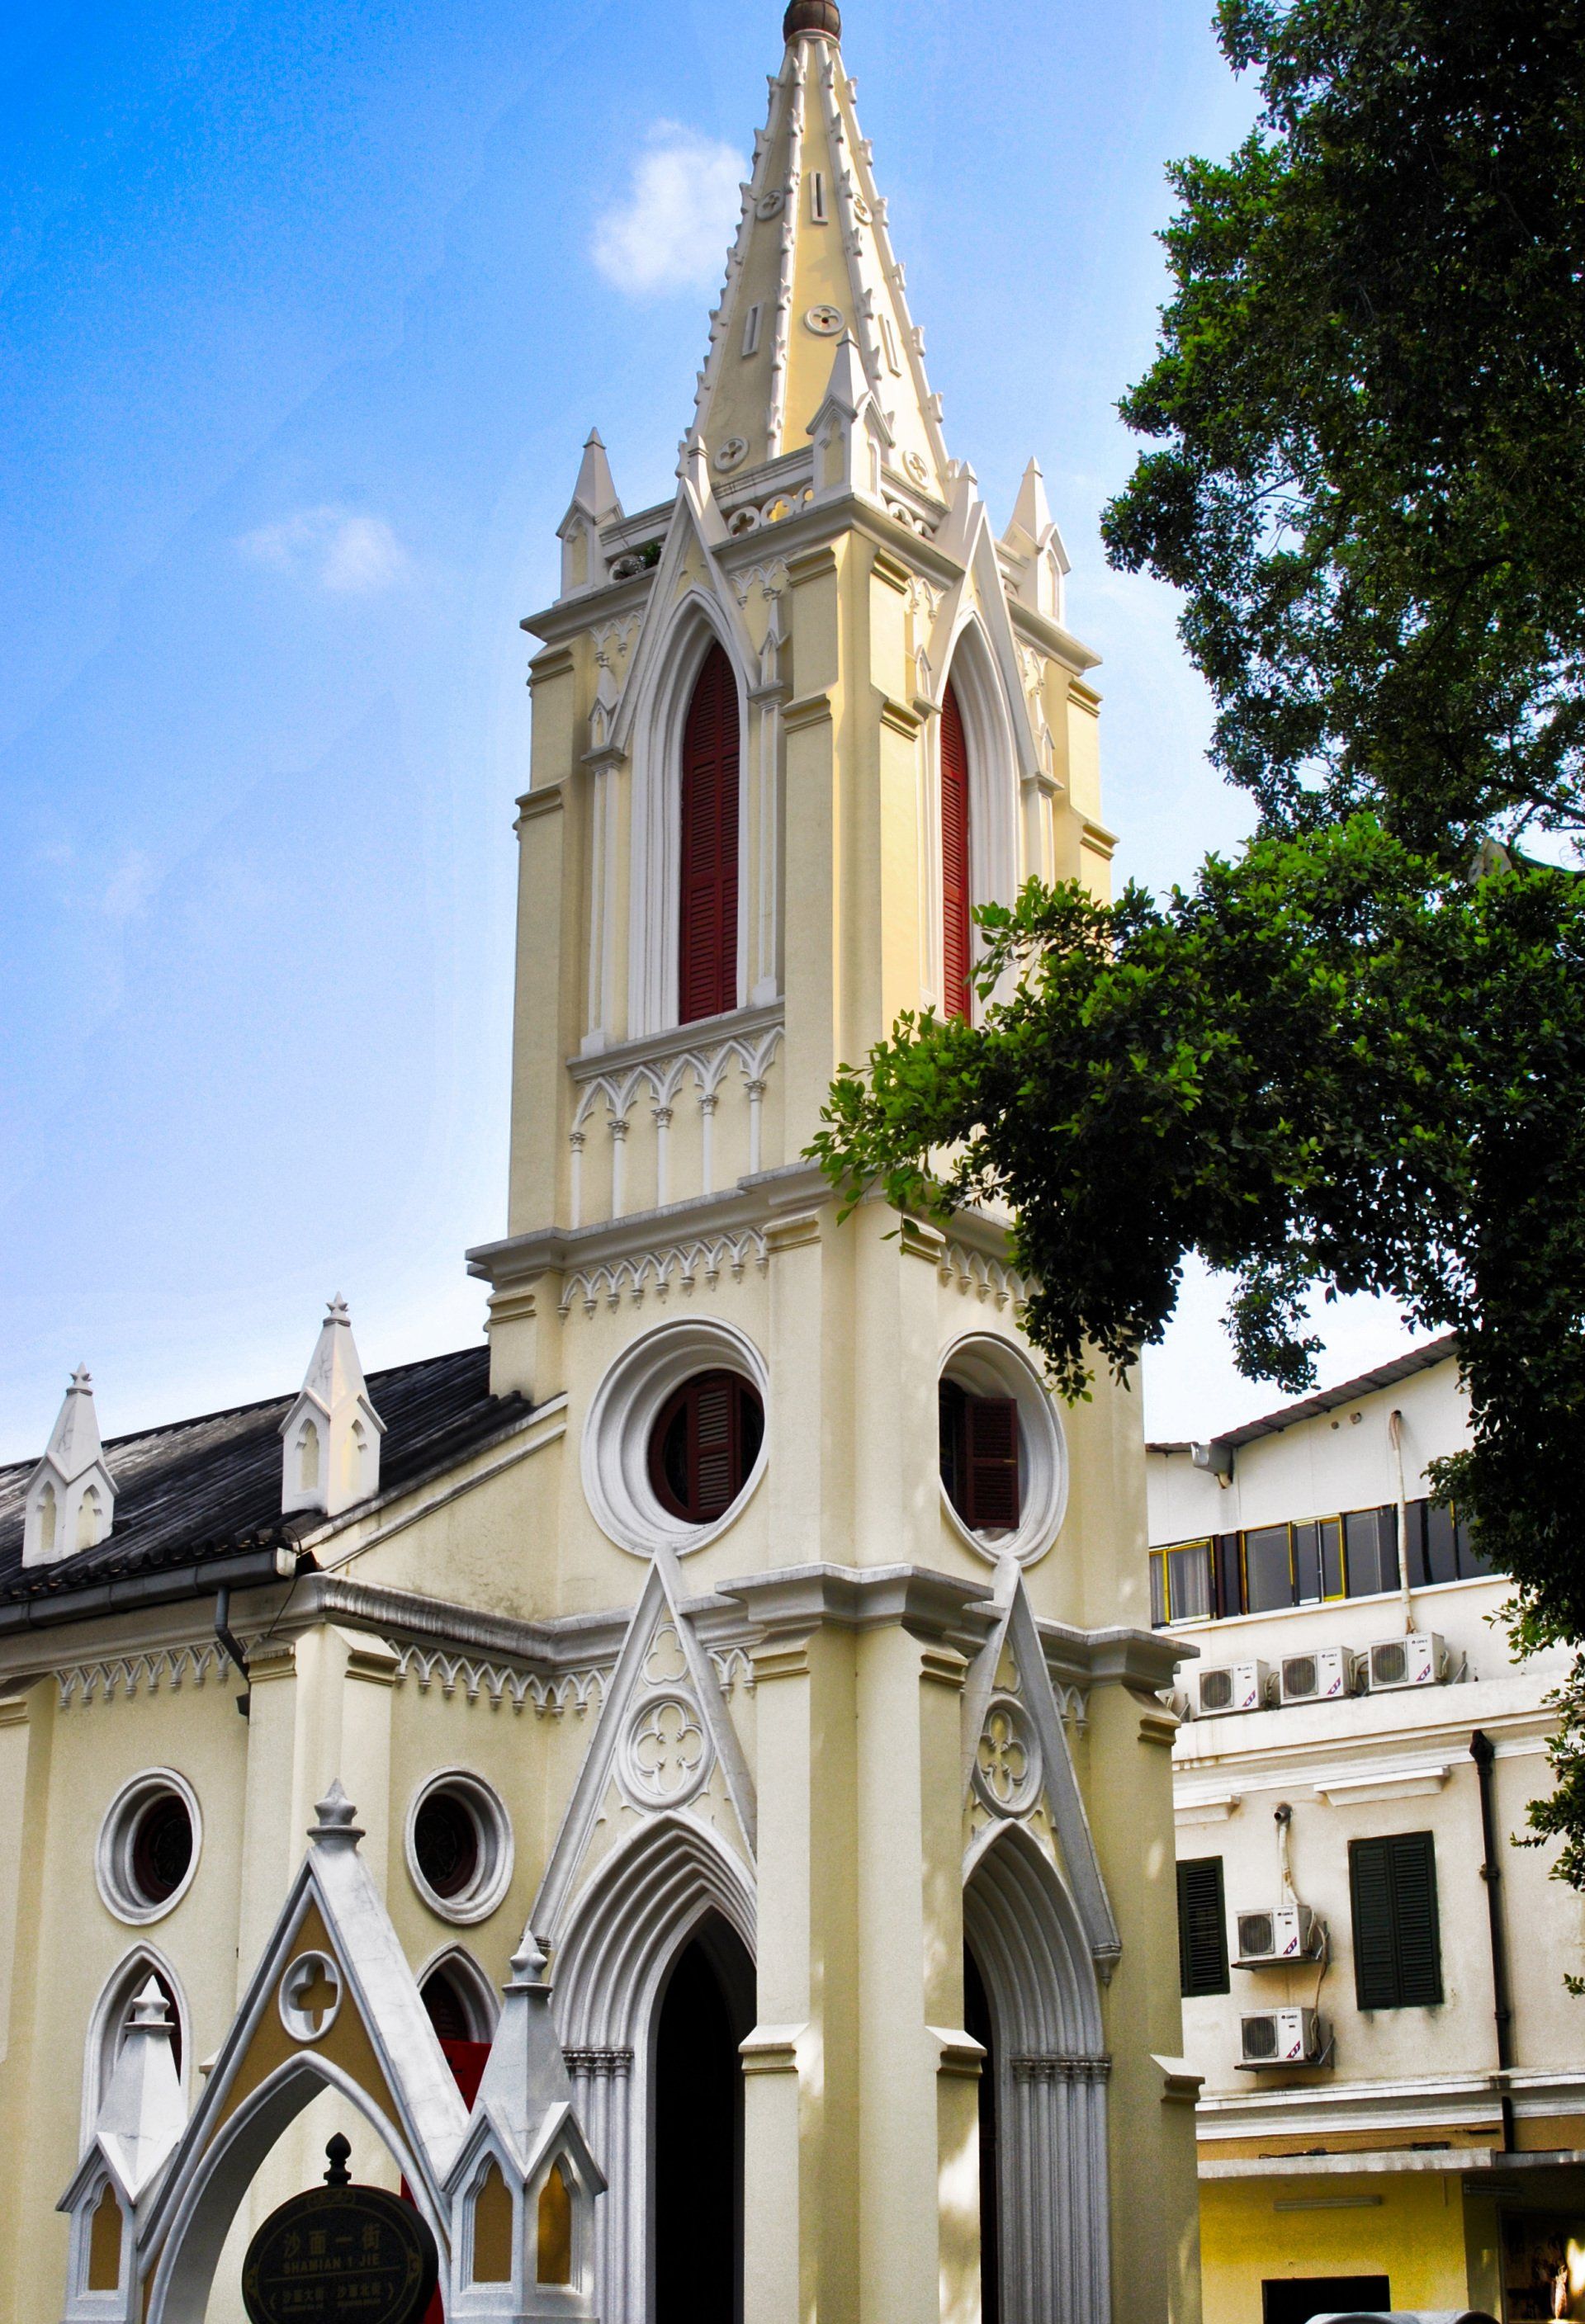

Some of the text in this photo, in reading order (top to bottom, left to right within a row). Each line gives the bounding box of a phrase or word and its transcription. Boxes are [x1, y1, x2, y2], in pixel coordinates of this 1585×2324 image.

[283, 2222, 381, 2258] 沙面一街
[283, 2253, 381, 2274] SHAMIAN 1 JIE
